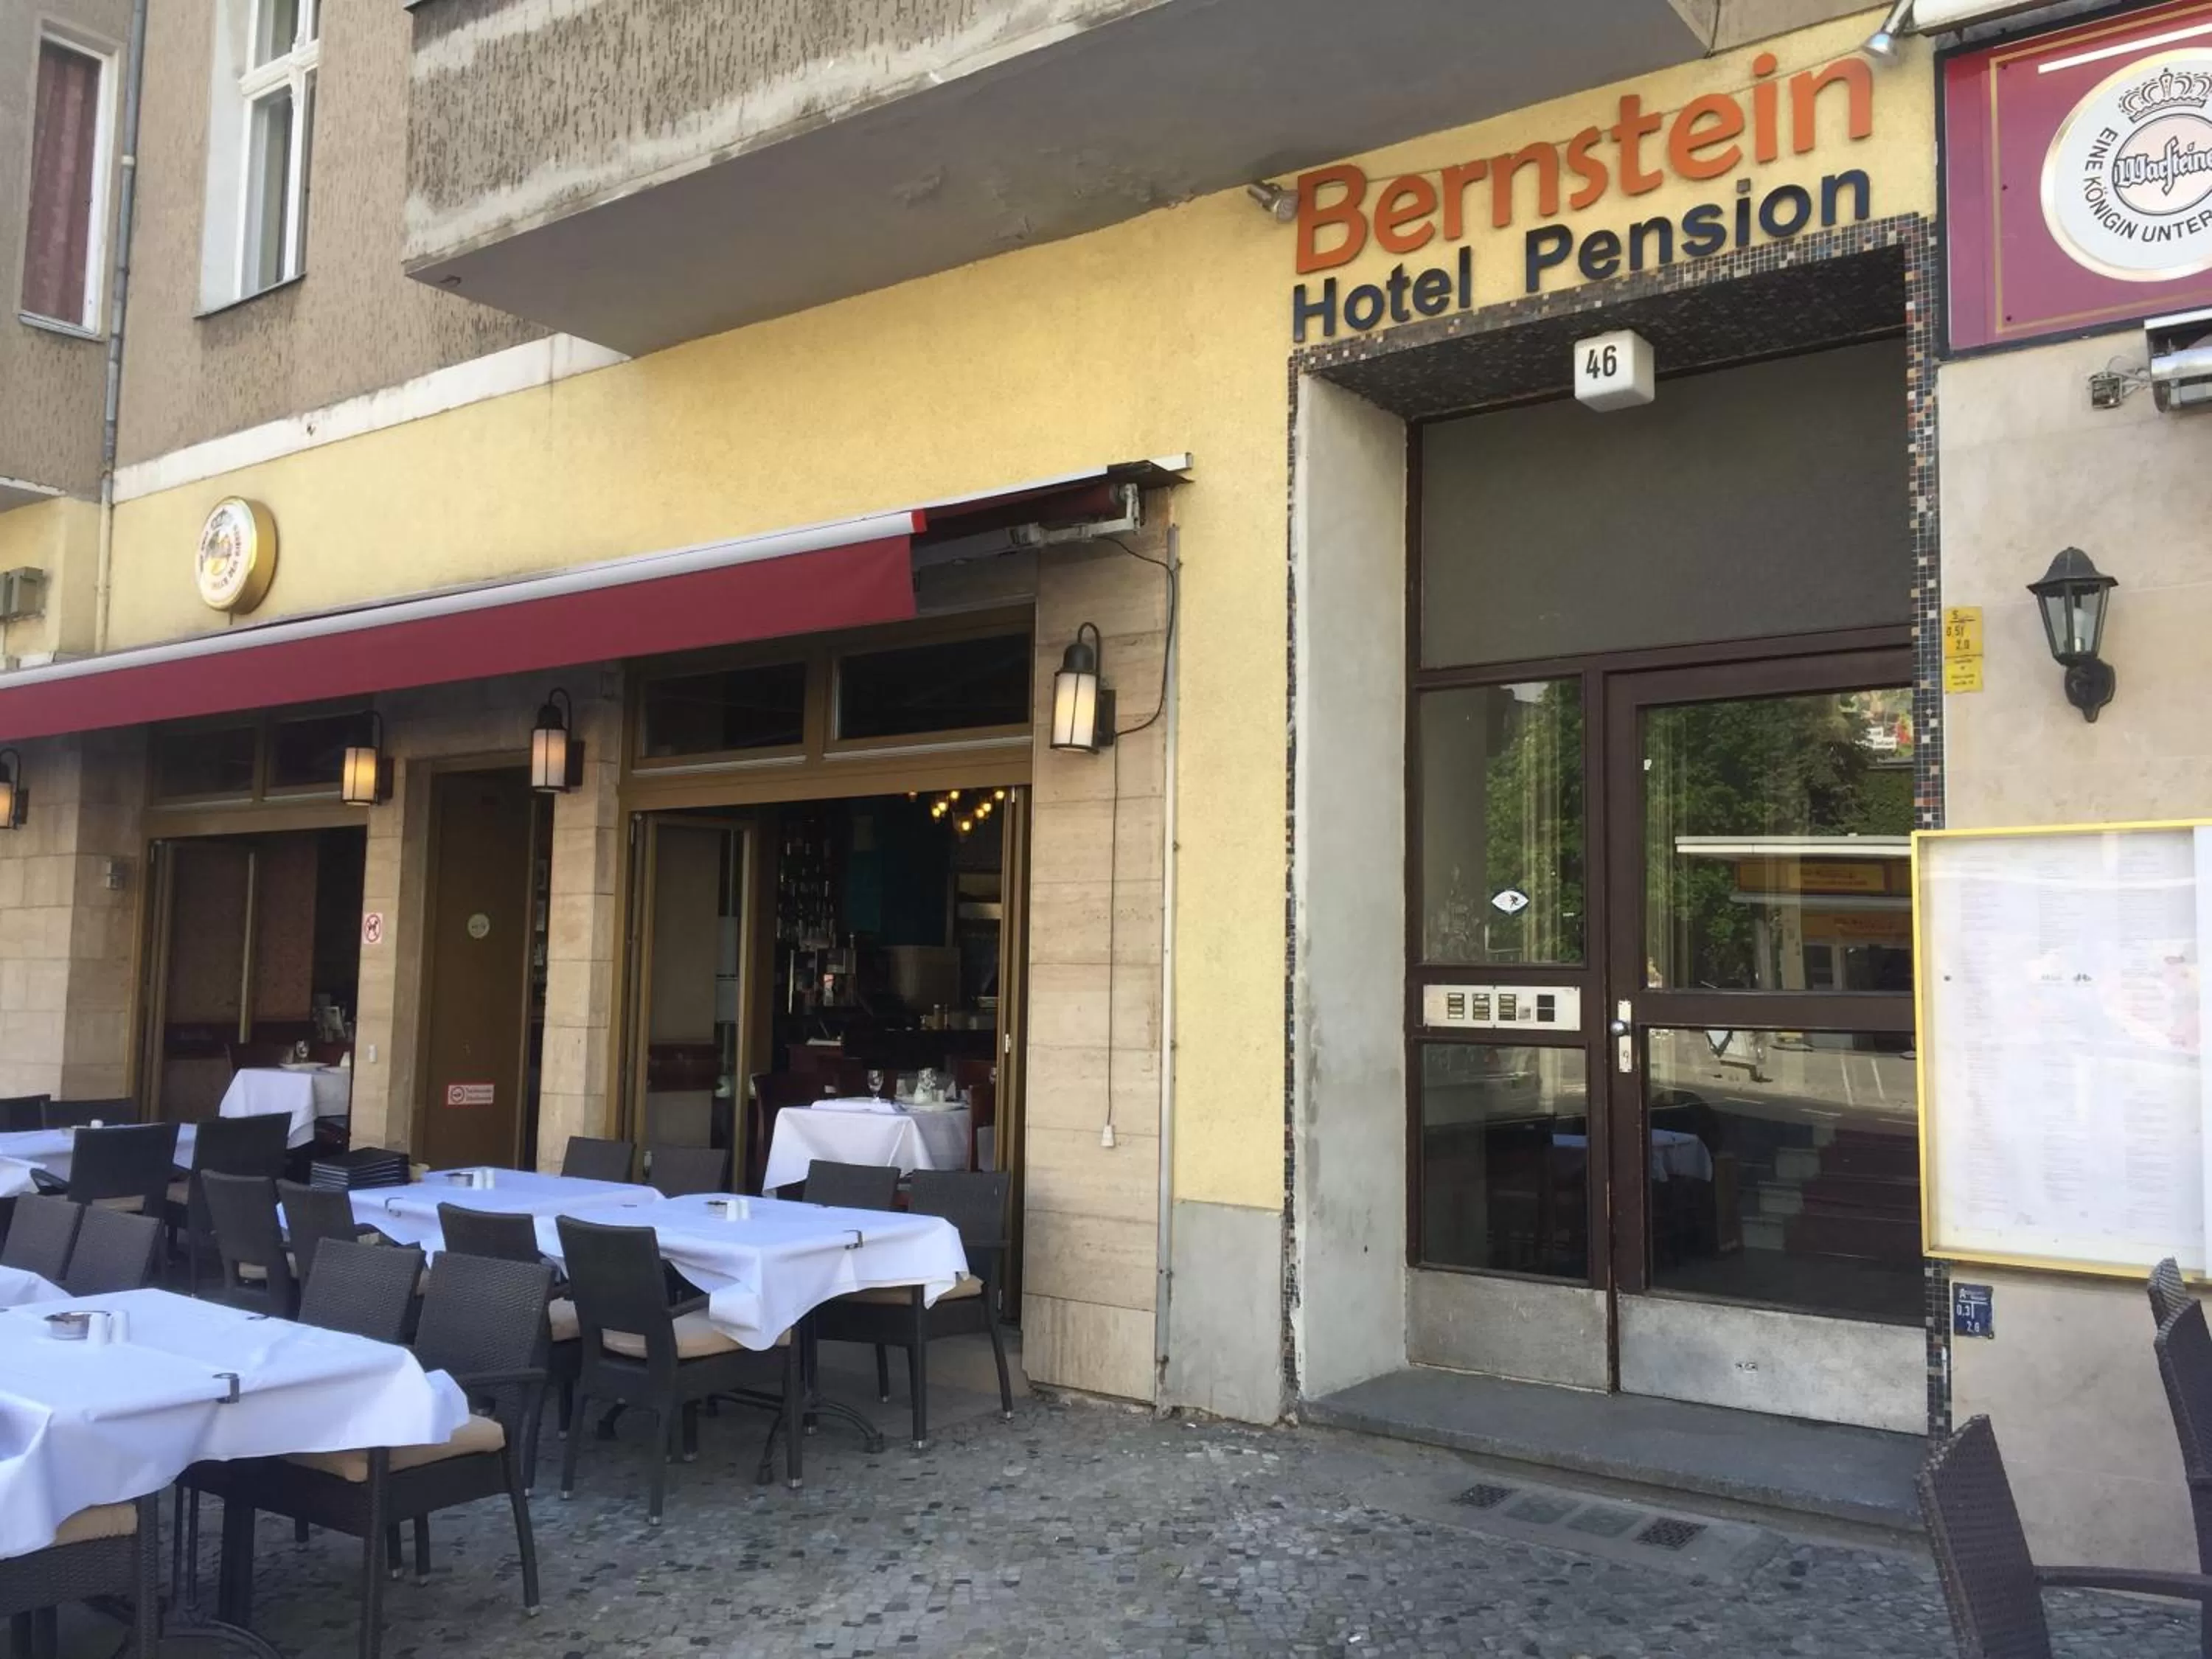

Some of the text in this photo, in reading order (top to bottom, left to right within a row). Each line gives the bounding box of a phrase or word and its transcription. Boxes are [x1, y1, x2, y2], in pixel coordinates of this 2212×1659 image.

[1296, 52, 1874, 274] Bernstein
[2084, 127, 2119, 172] EINE
[2083, 176, 2138, 240] KÖNIGIN
[1293, 168, 1871, 343] Hotel Pension
[1586, 344, 1617, 379] 46
